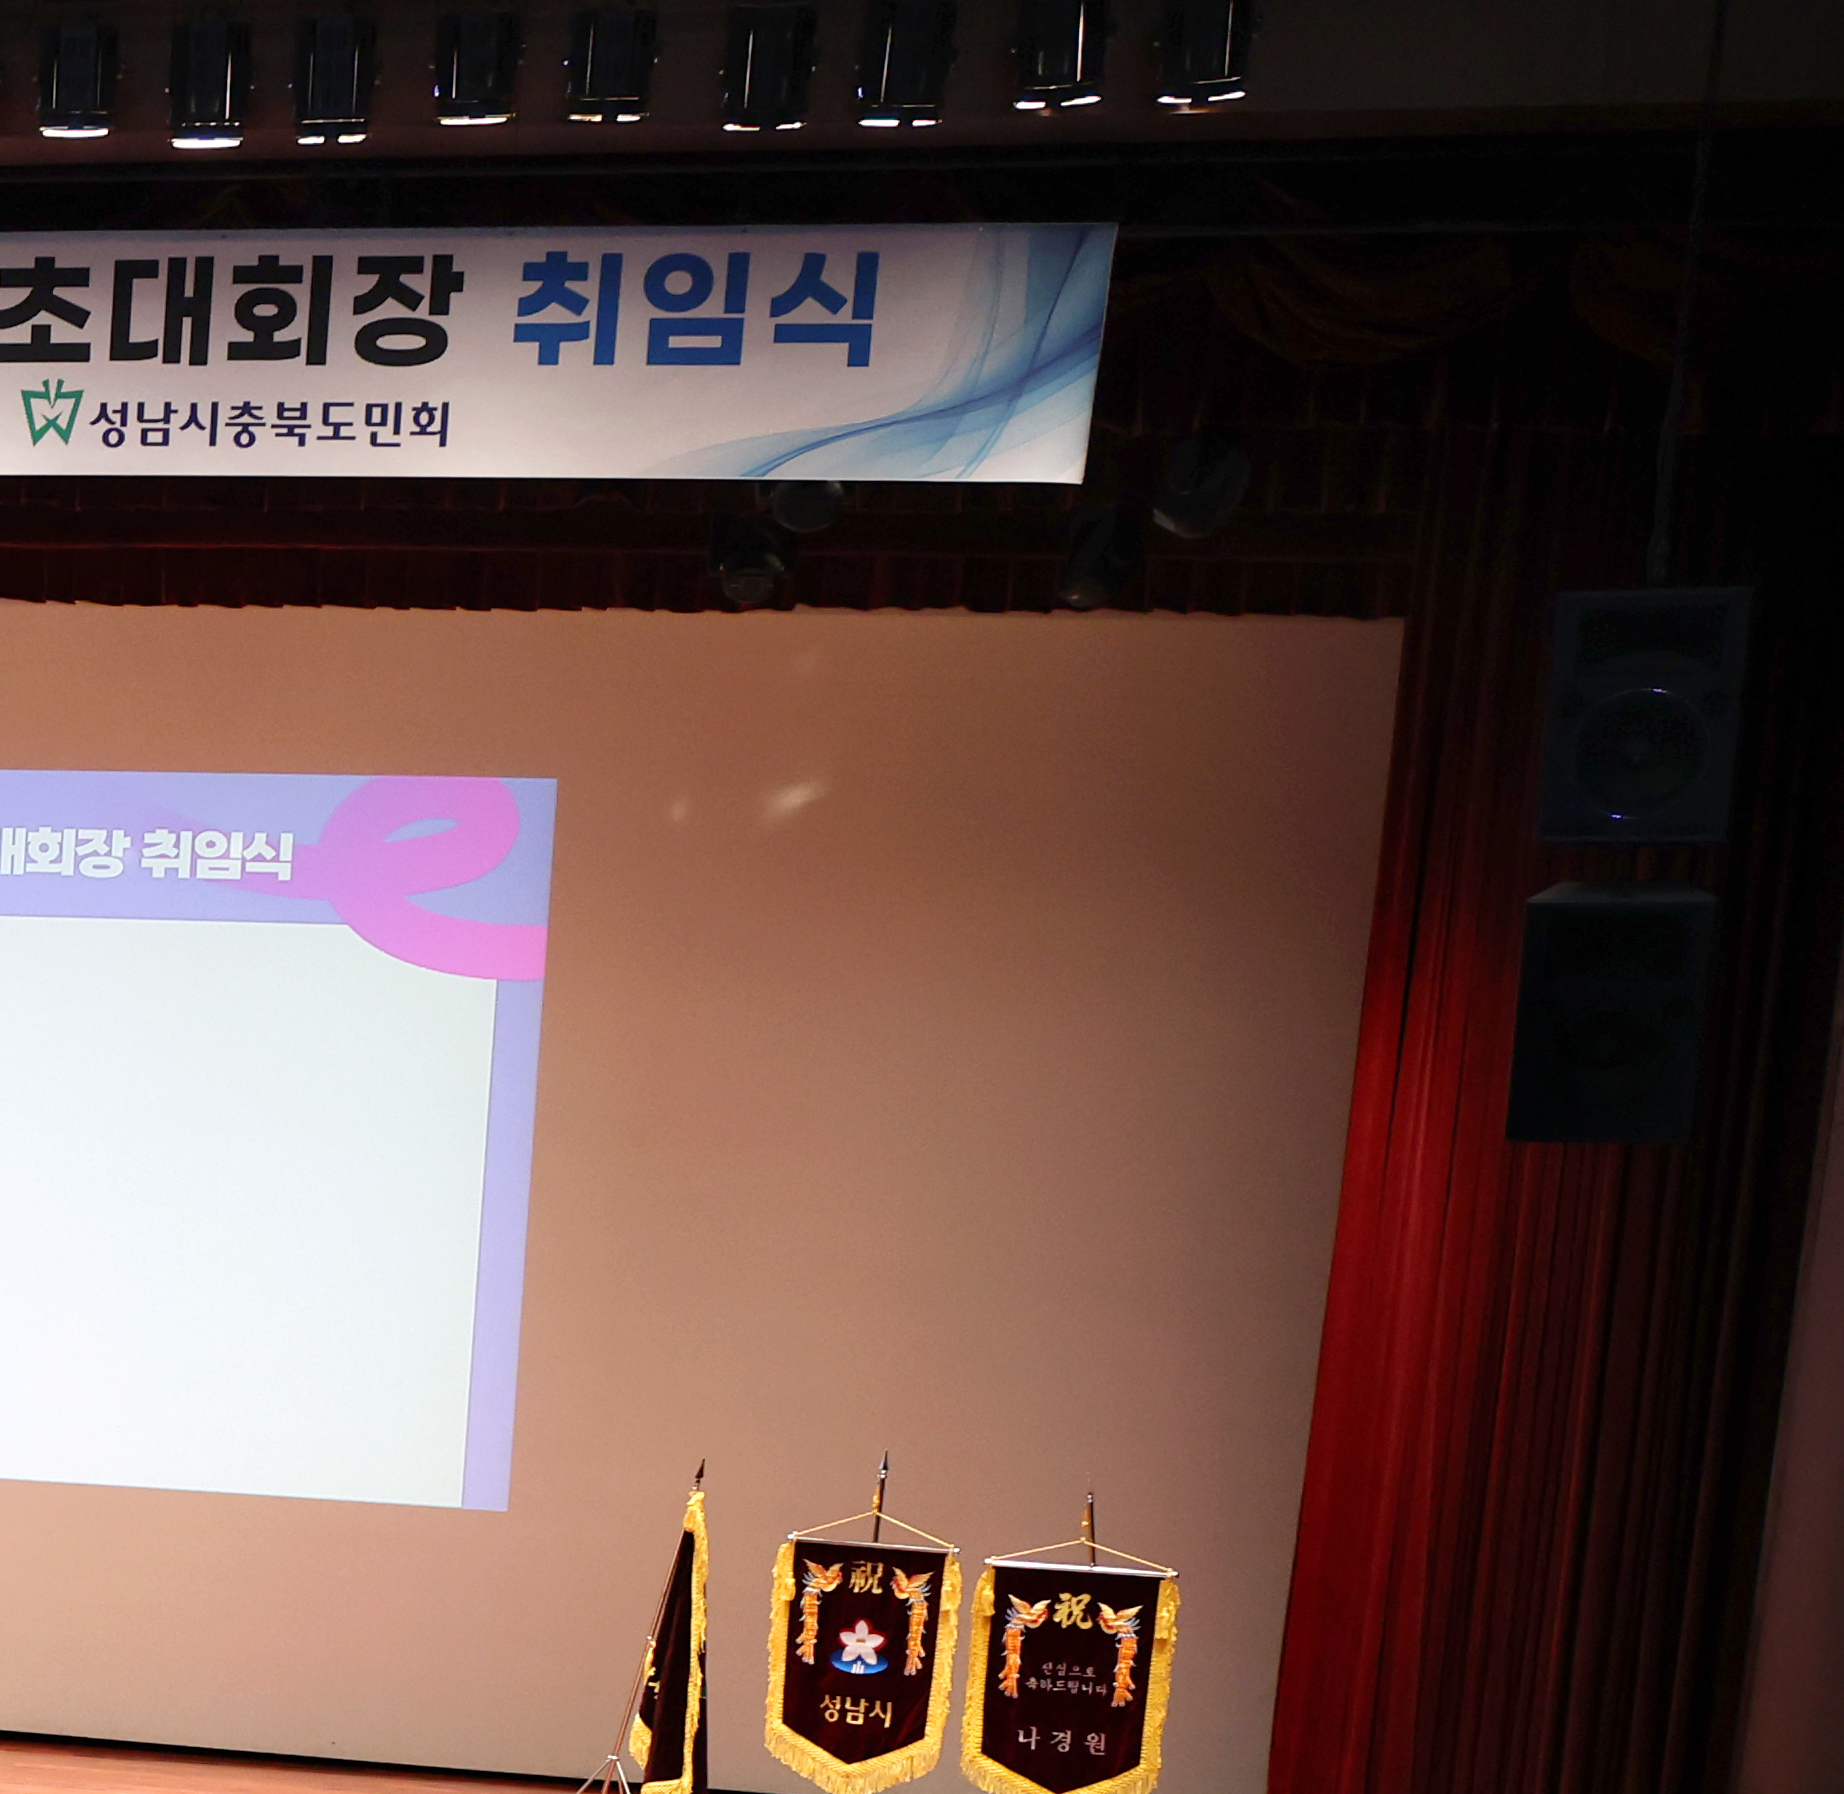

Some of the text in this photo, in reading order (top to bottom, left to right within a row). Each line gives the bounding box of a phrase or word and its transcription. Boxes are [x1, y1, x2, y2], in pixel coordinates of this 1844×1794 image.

[512, 250, 882, 368] 취임식
[90, 401, 449, 448] 성남시충북도민회
[140, 829, 295, 882] 취임식
[849, 1561, 882, 1594] 祝
[1053, 1593, 1092, 1629] 祝
[821, 1695, 891, 1728] 성남시
[1018, 1727, 1105, 1755] 나경원
